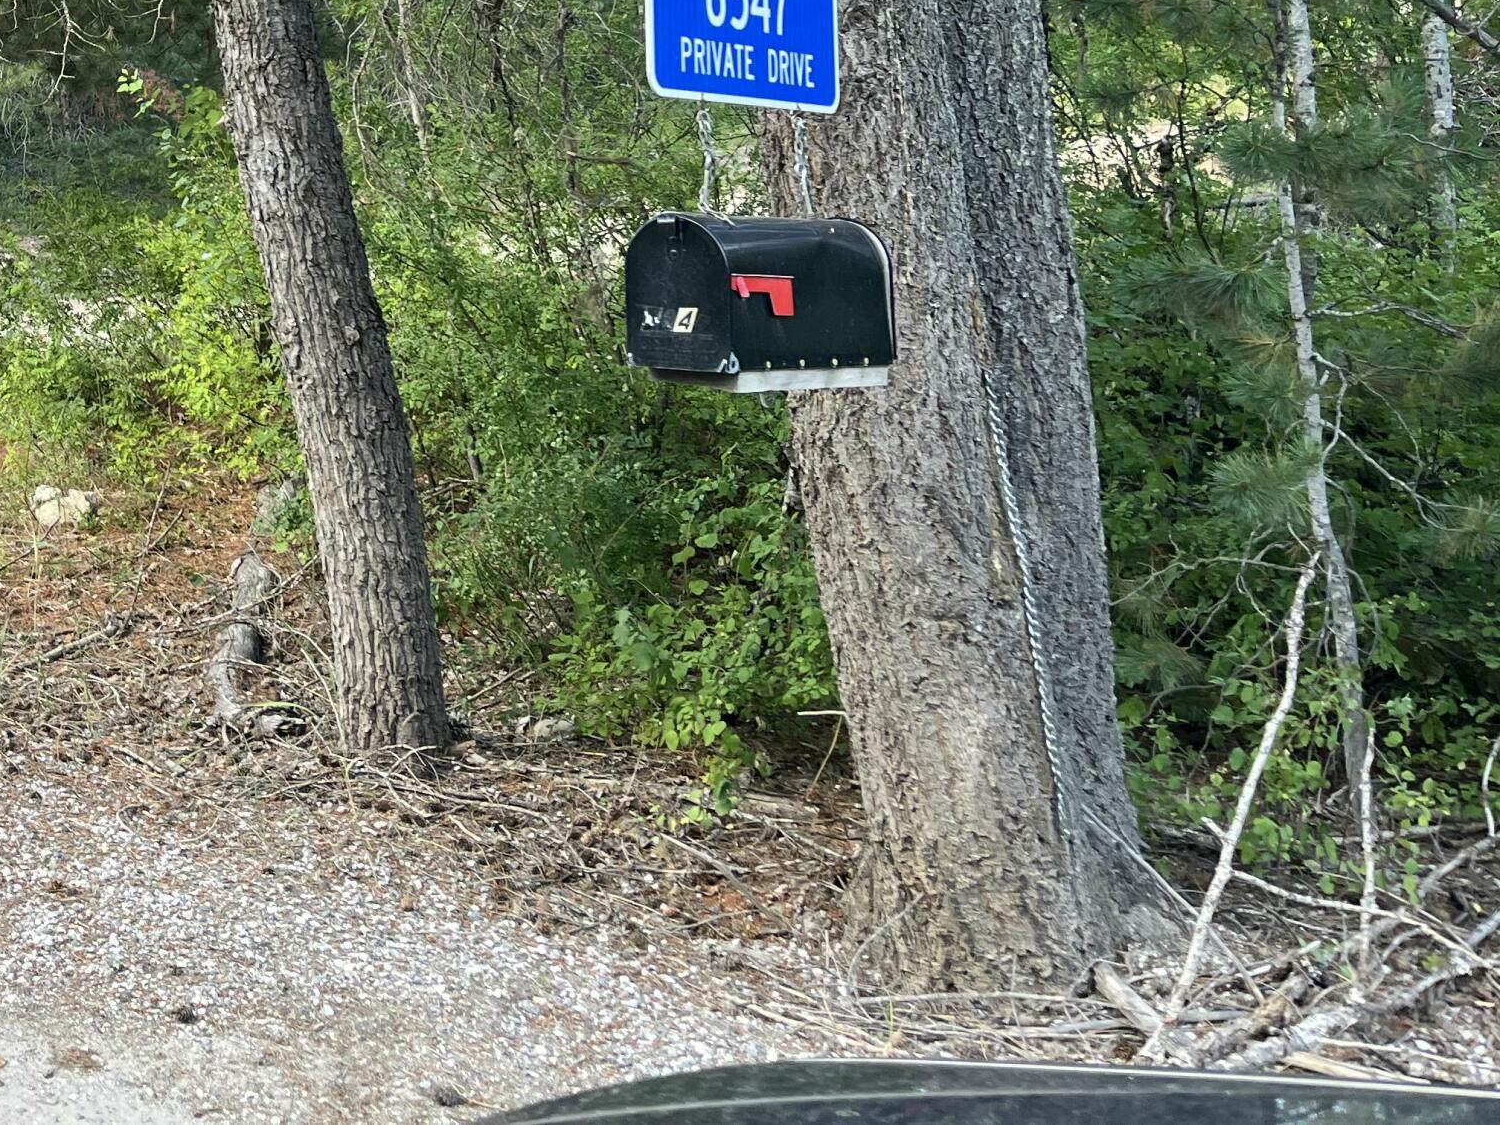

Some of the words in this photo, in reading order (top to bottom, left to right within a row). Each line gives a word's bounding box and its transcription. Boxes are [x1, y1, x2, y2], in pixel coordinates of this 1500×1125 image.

[680, 36, 755, 81] PRIVATE
[767, 48, 815, 88] DRIVE
[677, 309, 695, 330] 4
